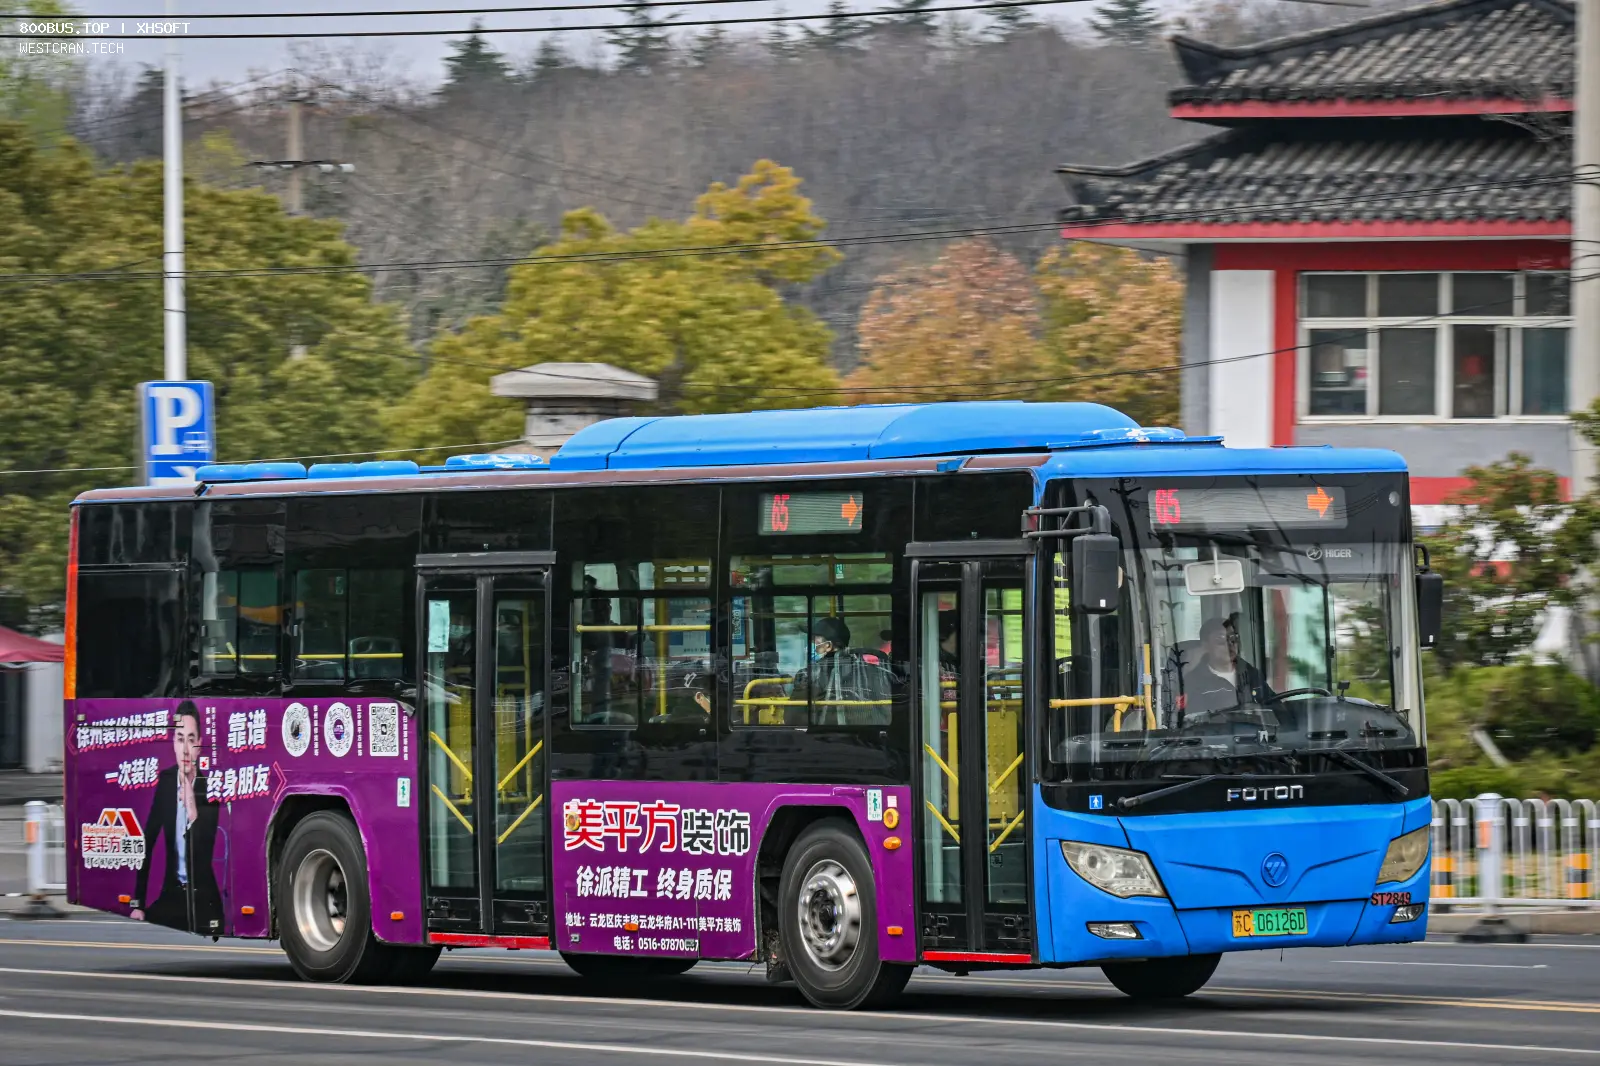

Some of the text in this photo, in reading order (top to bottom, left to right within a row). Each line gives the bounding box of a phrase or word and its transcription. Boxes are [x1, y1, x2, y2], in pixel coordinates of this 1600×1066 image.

[148, 386, 203, 455] P
[1325, 549, 1352, 558] HIGER
[227, 709, 267, 749] 靠谱
[105, 757, 270, 800] 一次装修 终身朋友
[1227, 785, 1303, 801] FOTON
[83, 835, 144, 853] 美平方装饰
[564, 799, 751, 855] 美平方装饰
[576, 865, 732, 900] 徐派精工 终身质保
[1371, 891, 1411, 905] ST2849
